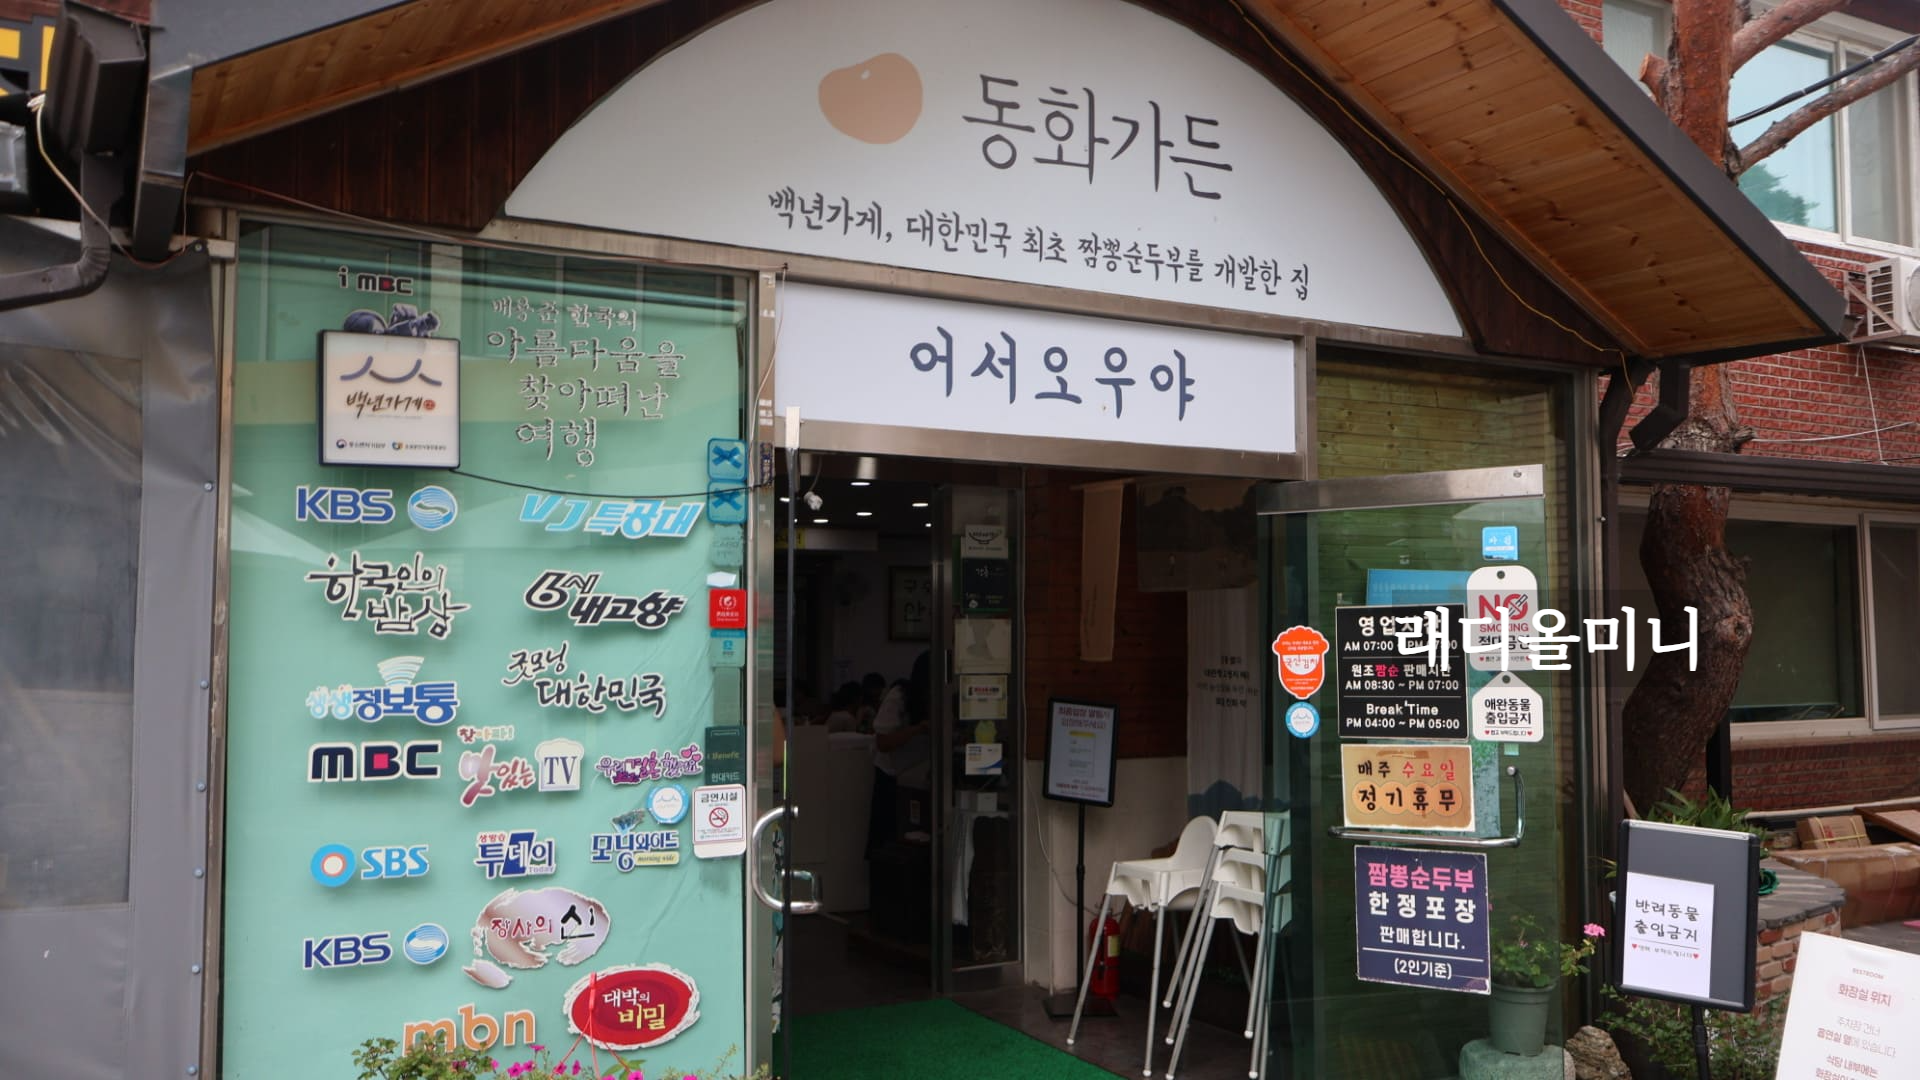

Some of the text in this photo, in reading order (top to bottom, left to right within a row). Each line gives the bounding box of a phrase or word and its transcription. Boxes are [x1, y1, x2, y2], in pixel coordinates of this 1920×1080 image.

[962, 74, 1233, 200] 동화가든
[768, 186, 1310, 301] 백년가게, 대한민국 최초 짬뽕순두부를 개발한 집
[567, 303, 638, 332] 한국의
[487, 326, 686, 379] 아름다움을
[346, 389, 423, 419] 백년가게
[515, 415, 597, 468] 여행
[297, 487, 394, 523] KBS
[519, 494, 706, 539] VJ 특공대
[305, 551, 447, 620] 한국인의
[524, 571, 600, 611] 6시
[365, 593, 471, 639] 밥상
[569, 590, 688, 629] 내고향
[1479, 594, 1528, 621] NO
[1480, 622, 1529, 632] SMOING
[1344, 641, 1394, 651] AM 07:00
[503, 641, 569, 685] 굿모닝
[535, 672, 667, 718] 대한민국
[1345, 681, 1361, 690] AM
[1364, 680, 1395, 690] 08:30
[1408, 681, 1424, 690] PM
[1428, 680, 1459, 690] 07:00
[1366, 703, 1439, 716] Break Time
[1484, 698, 1531, 712] 애완동물
[1485, 711, 1532, 726] 출입금지
[1346, 718, 1361, 728] PM
[1364, 718, 1396, 728] 04:00
[1408, 719, 1425, 729] PM
[1428, 719, 1460, 729] 05:00
[309, 743, 440, 781] MBC
[460, 745, 534, 806] 맛있는
[543, 755, 578, 785] TV
[711, 771, 740, 783] 현대카드
[1358, 758, 1455, 780] 매주 수요일
[700, 790, 738, 804] 금연시설
[1358, 784, 1456, 812] 정기휴무
[362, 846, 429, 878] SBS
[476, 840, 554, 878] 투데이
[591, 832, 678, 872] 모닝와이드
[1368, 862, 1475, 893] 짬뽕순두부
[491, 904, 595, 940] 장사의 신
[1635, 899, 1700, 922] 반려동물
[1379, 926, 1466, 950] 판매합니다.
[1634, 919, 1698, 942] 출입금지
[304, 933, 391, 969] KBS
[1394, 959, 1453, 980] (2인기준)
[602, 987, 650, 1007] 대박의
[1838, 983, 1892, 1007] 화장실 위치
[402, 1004, 535, 1058] mbn
[618, 1003, 667, 1030] 비밀
